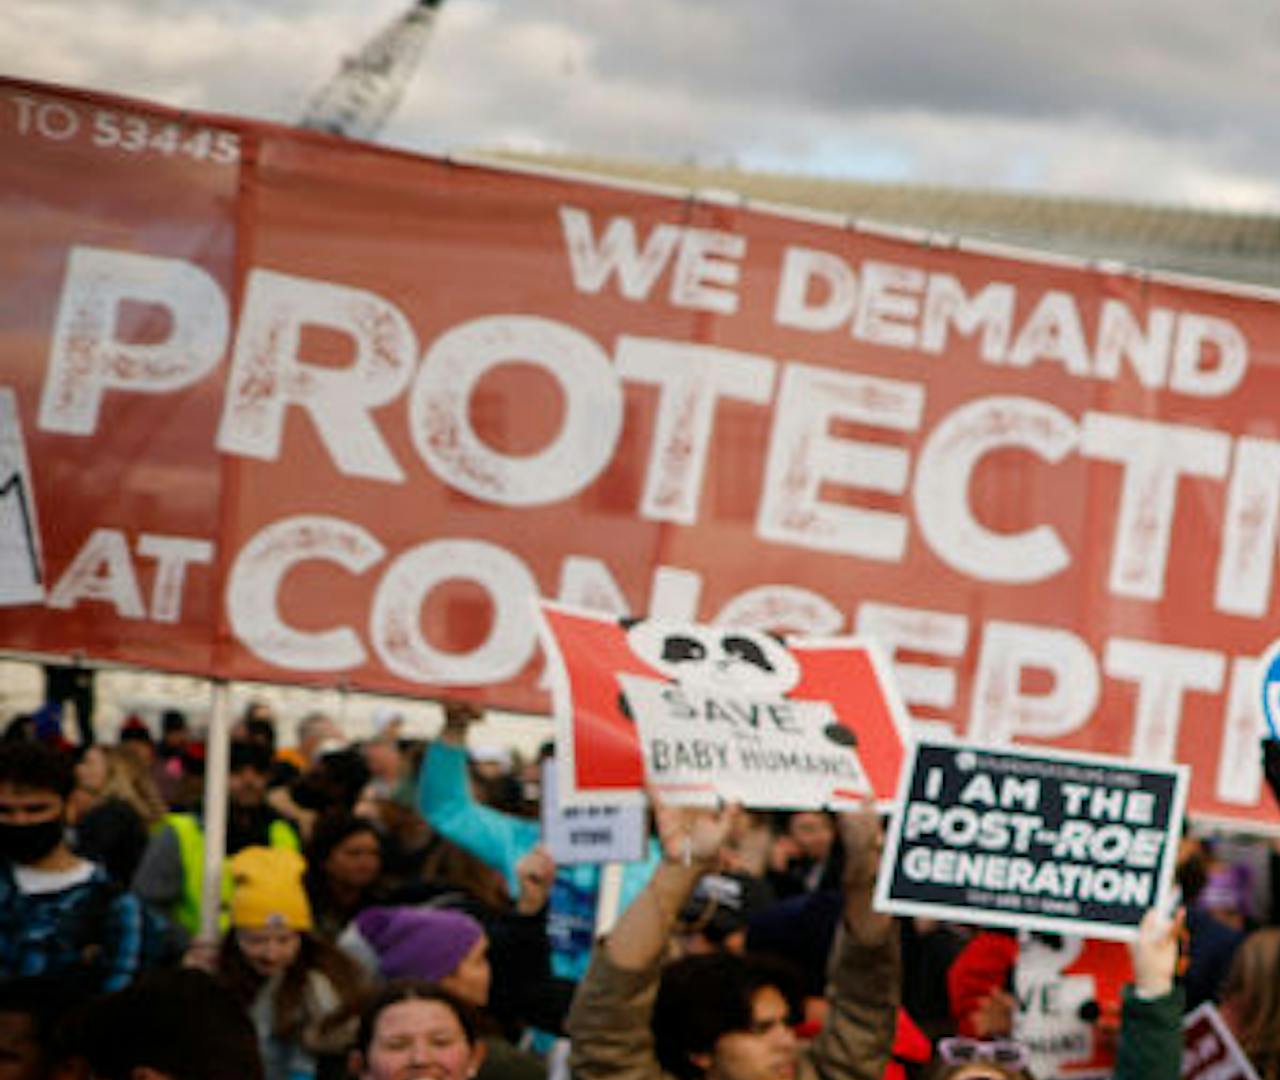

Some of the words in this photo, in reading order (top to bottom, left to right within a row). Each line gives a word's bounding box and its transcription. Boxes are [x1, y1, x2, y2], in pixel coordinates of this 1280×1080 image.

[12, 95, 77, 143] TO
[92, 113, 241, 166] 53445
[559, 205, 747, 317] WE
[773, 246, 1247, 397] DEMAND
[48, 527, 214, 623] AT
[660, 683, 806, 737] SAVE
[650, 737, 728, 773] BABY
[925, 766, 943, 800] I
[959, 773, 1043, 812] AM
[1060, 783, 1157, 824] THE
[905, 801, 1167, 868] POST-ROE
[902, 846, 1154, 907] GENERATION
